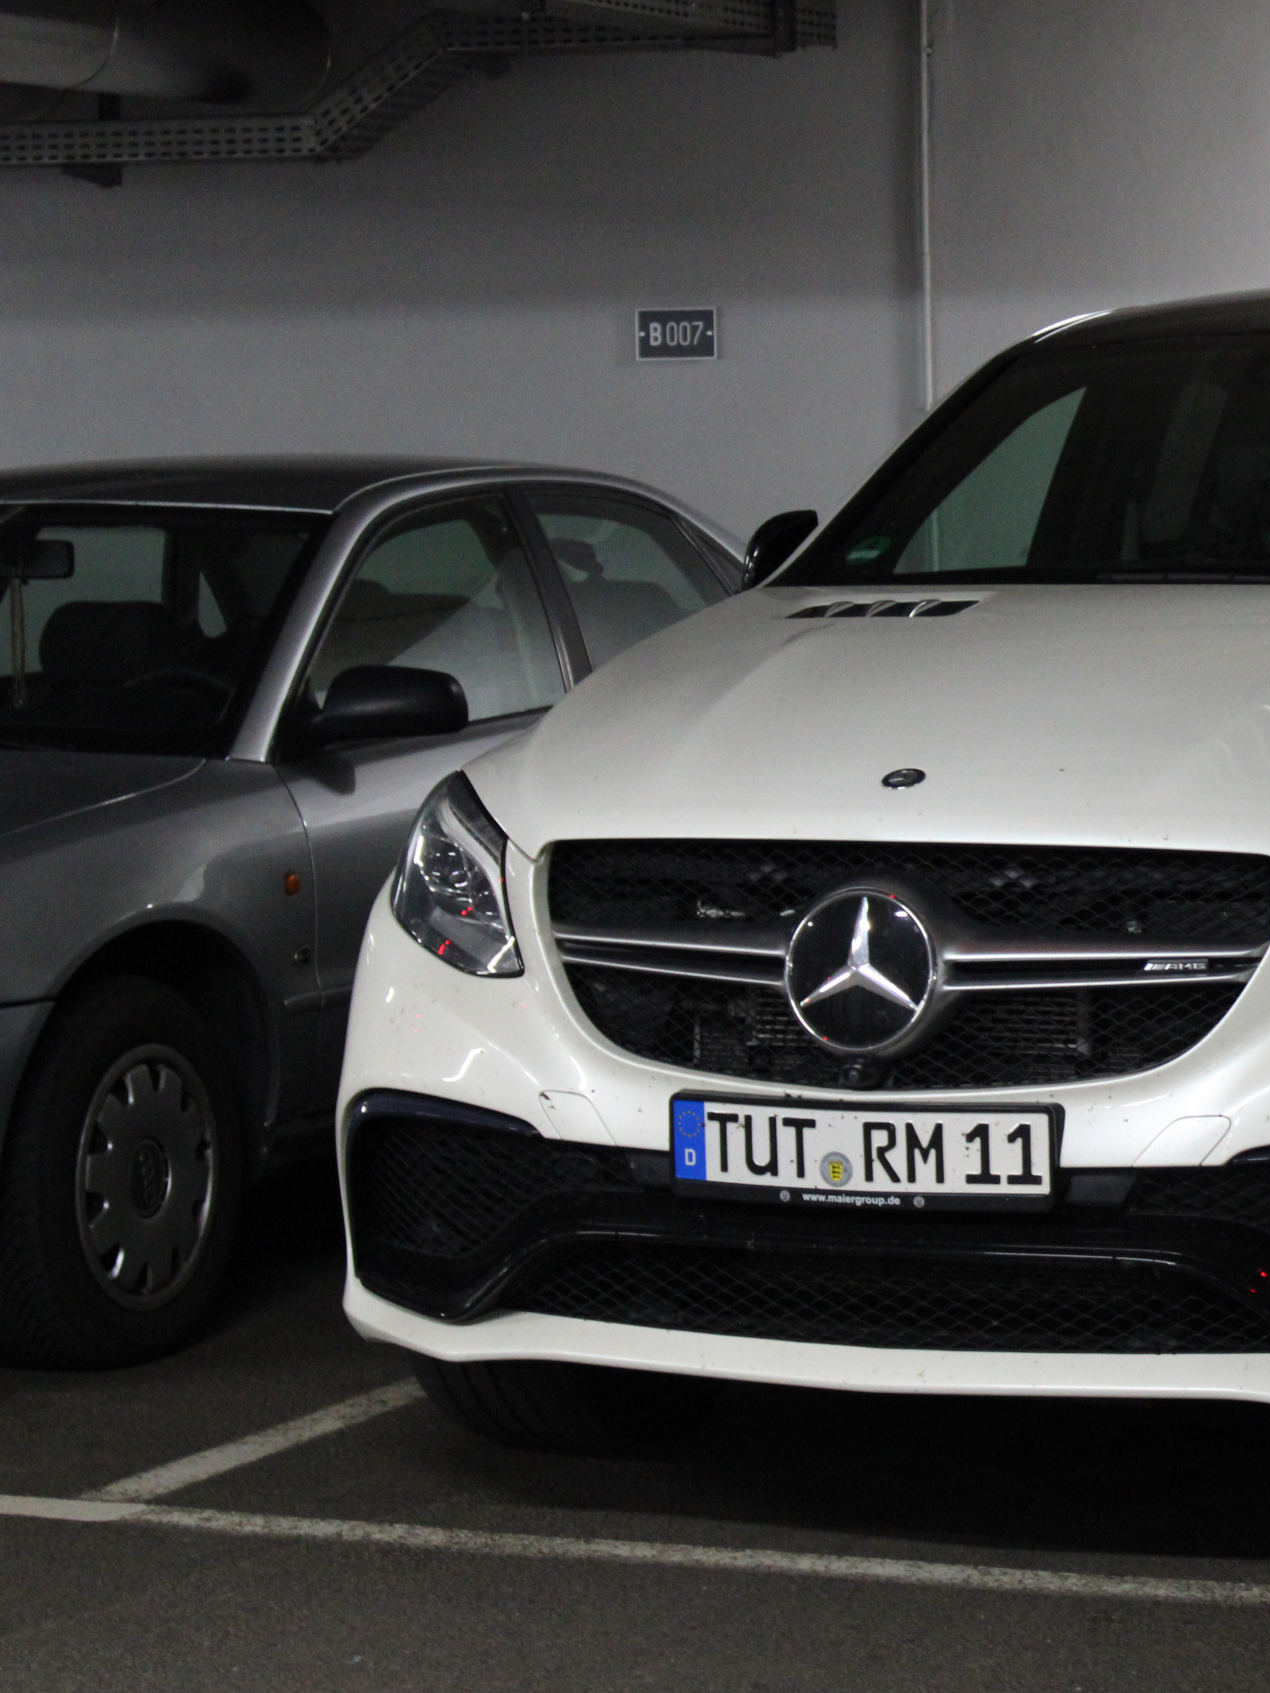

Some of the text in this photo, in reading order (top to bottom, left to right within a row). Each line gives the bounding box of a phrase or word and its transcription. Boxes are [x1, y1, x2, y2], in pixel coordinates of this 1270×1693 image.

[649, 321, 704, 346] B 007
[684, 1148, 697, 1166] D
[707, 1111, 1042, 1185] TUT RM 11
[802, 1193, 901, 1207] www.maiergroup.de
